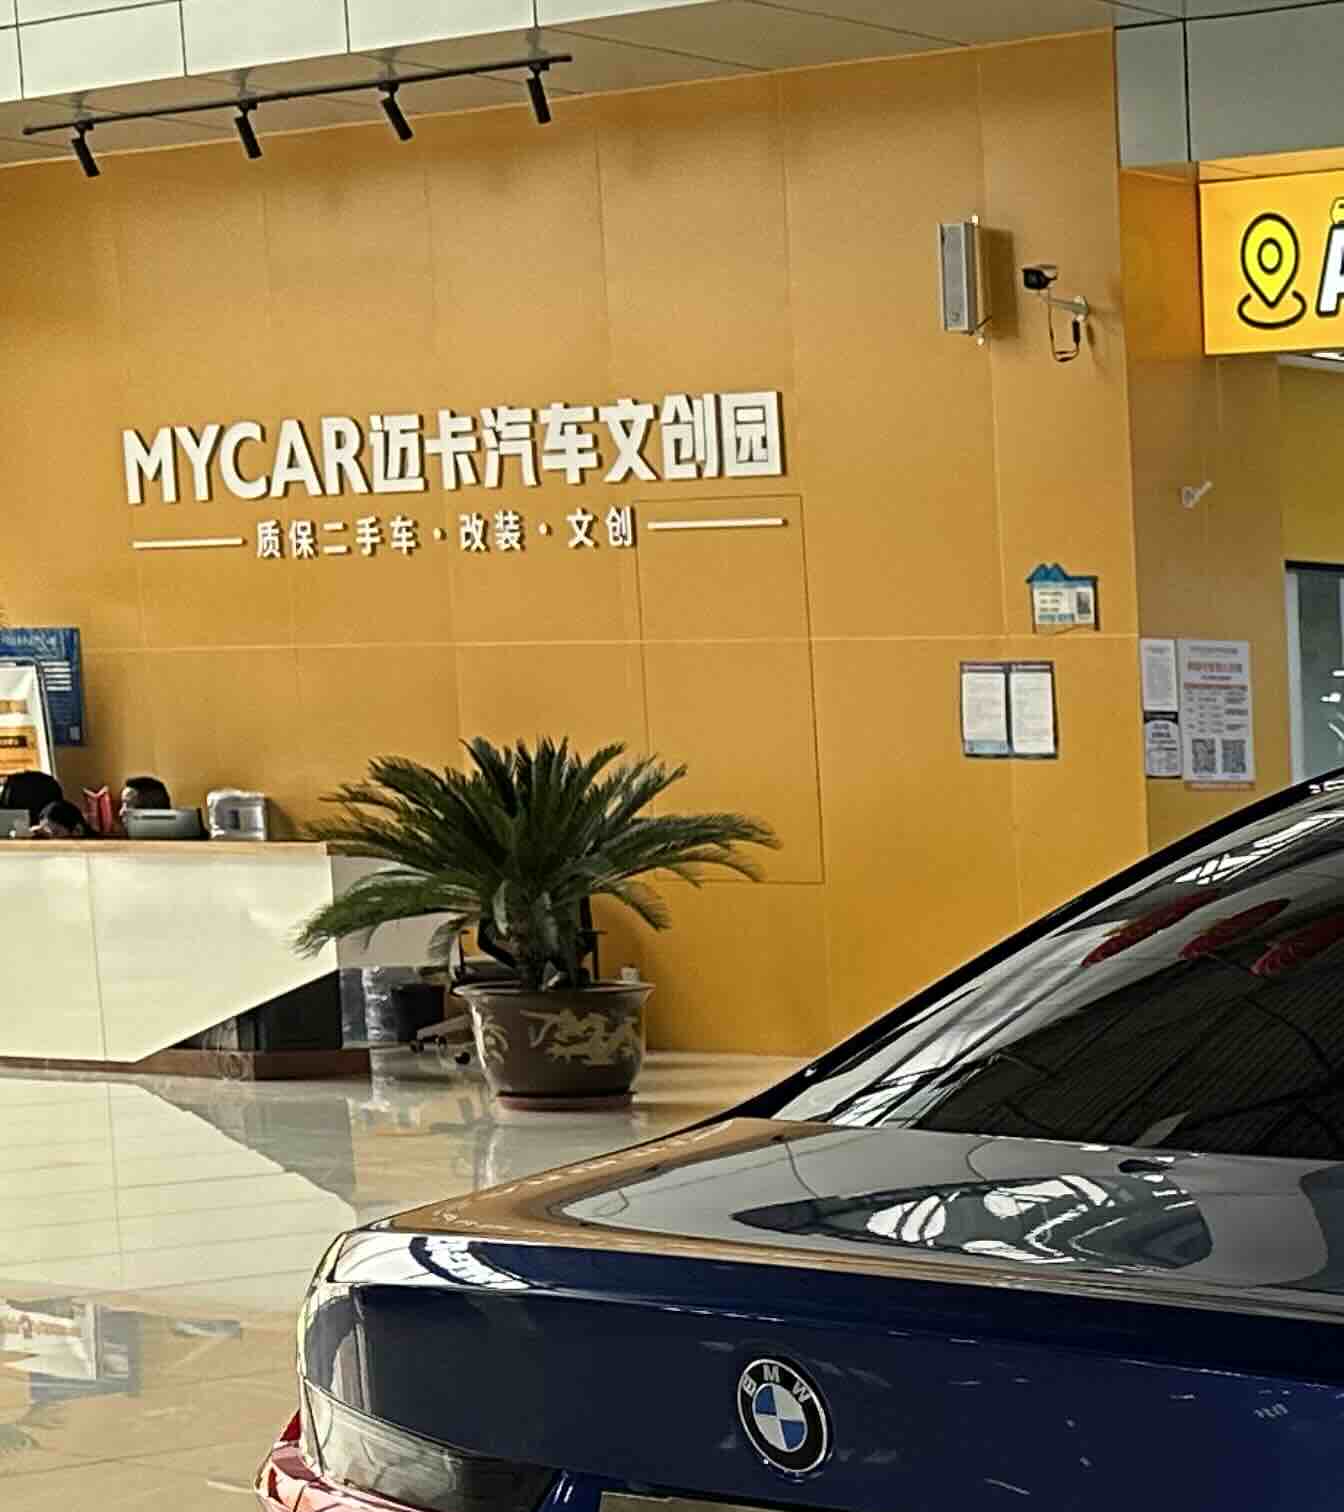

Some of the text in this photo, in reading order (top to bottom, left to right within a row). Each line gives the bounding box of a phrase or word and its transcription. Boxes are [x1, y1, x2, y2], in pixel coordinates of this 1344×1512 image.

[122, 390, 783, 506] MYCAR迈卡汽车文创园
[742, 1364, 811, 1403] BMW
